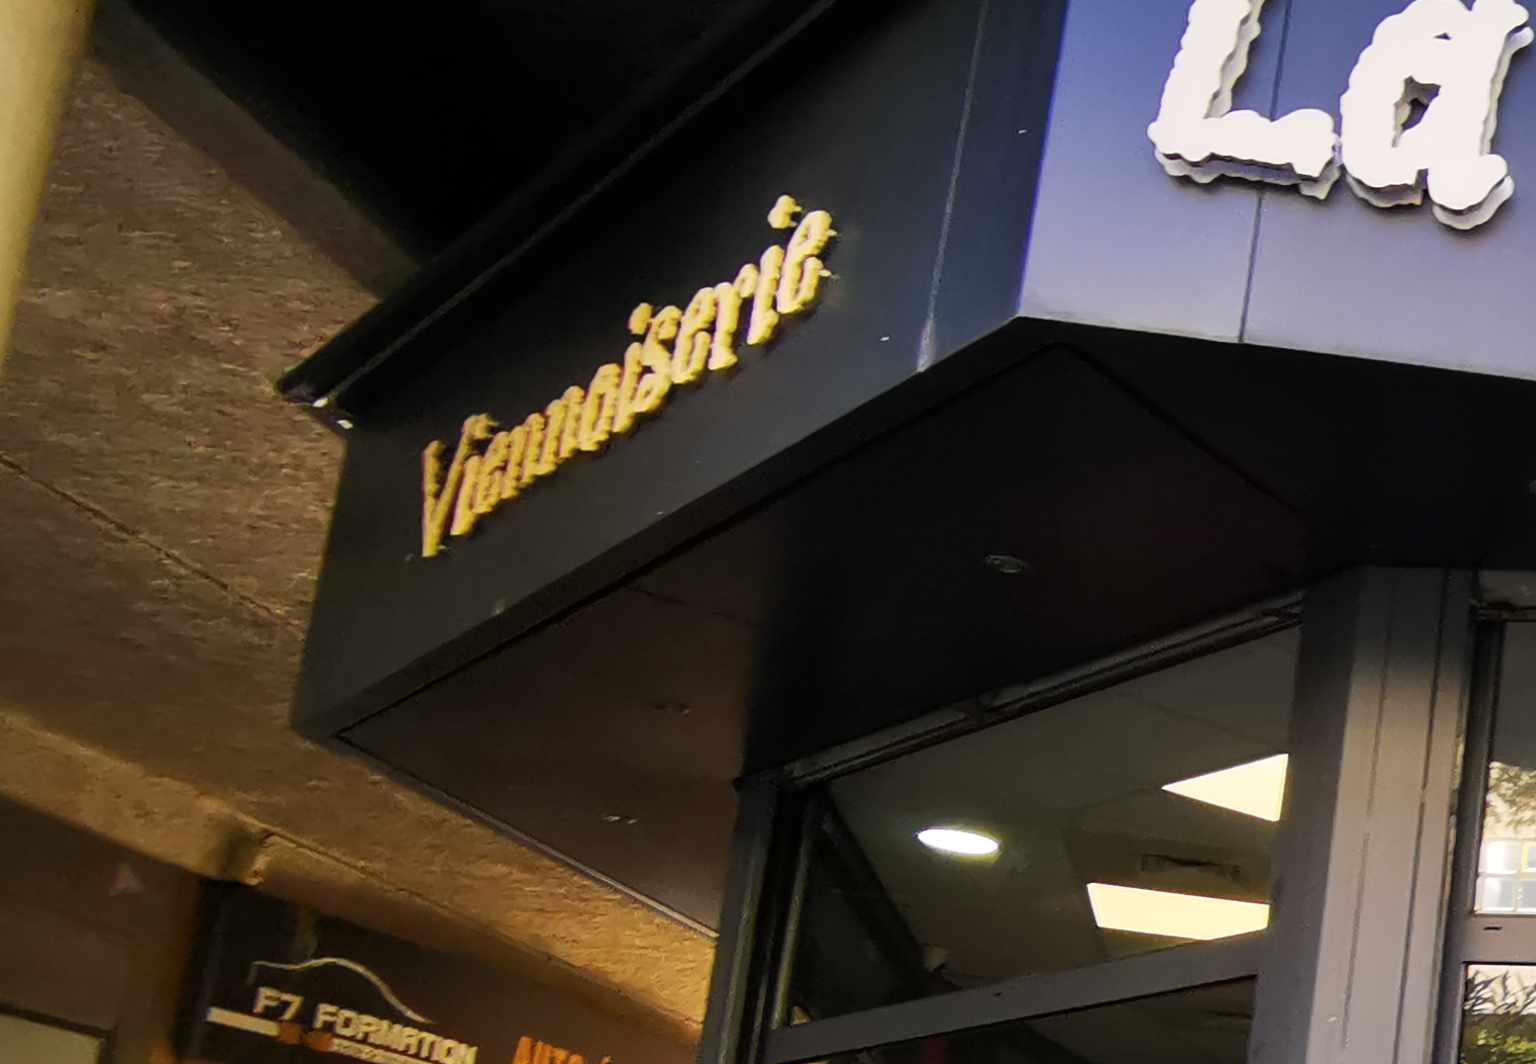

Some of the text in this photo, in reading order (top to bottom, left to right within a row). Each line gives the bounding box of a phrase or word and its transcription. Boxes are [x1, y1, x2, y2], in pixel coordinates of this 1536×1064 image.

[1148, 0, 1534, 230] La
[420, 195, 837, 559] Viennoiserie
[253, 986, 304, 1021] F7
